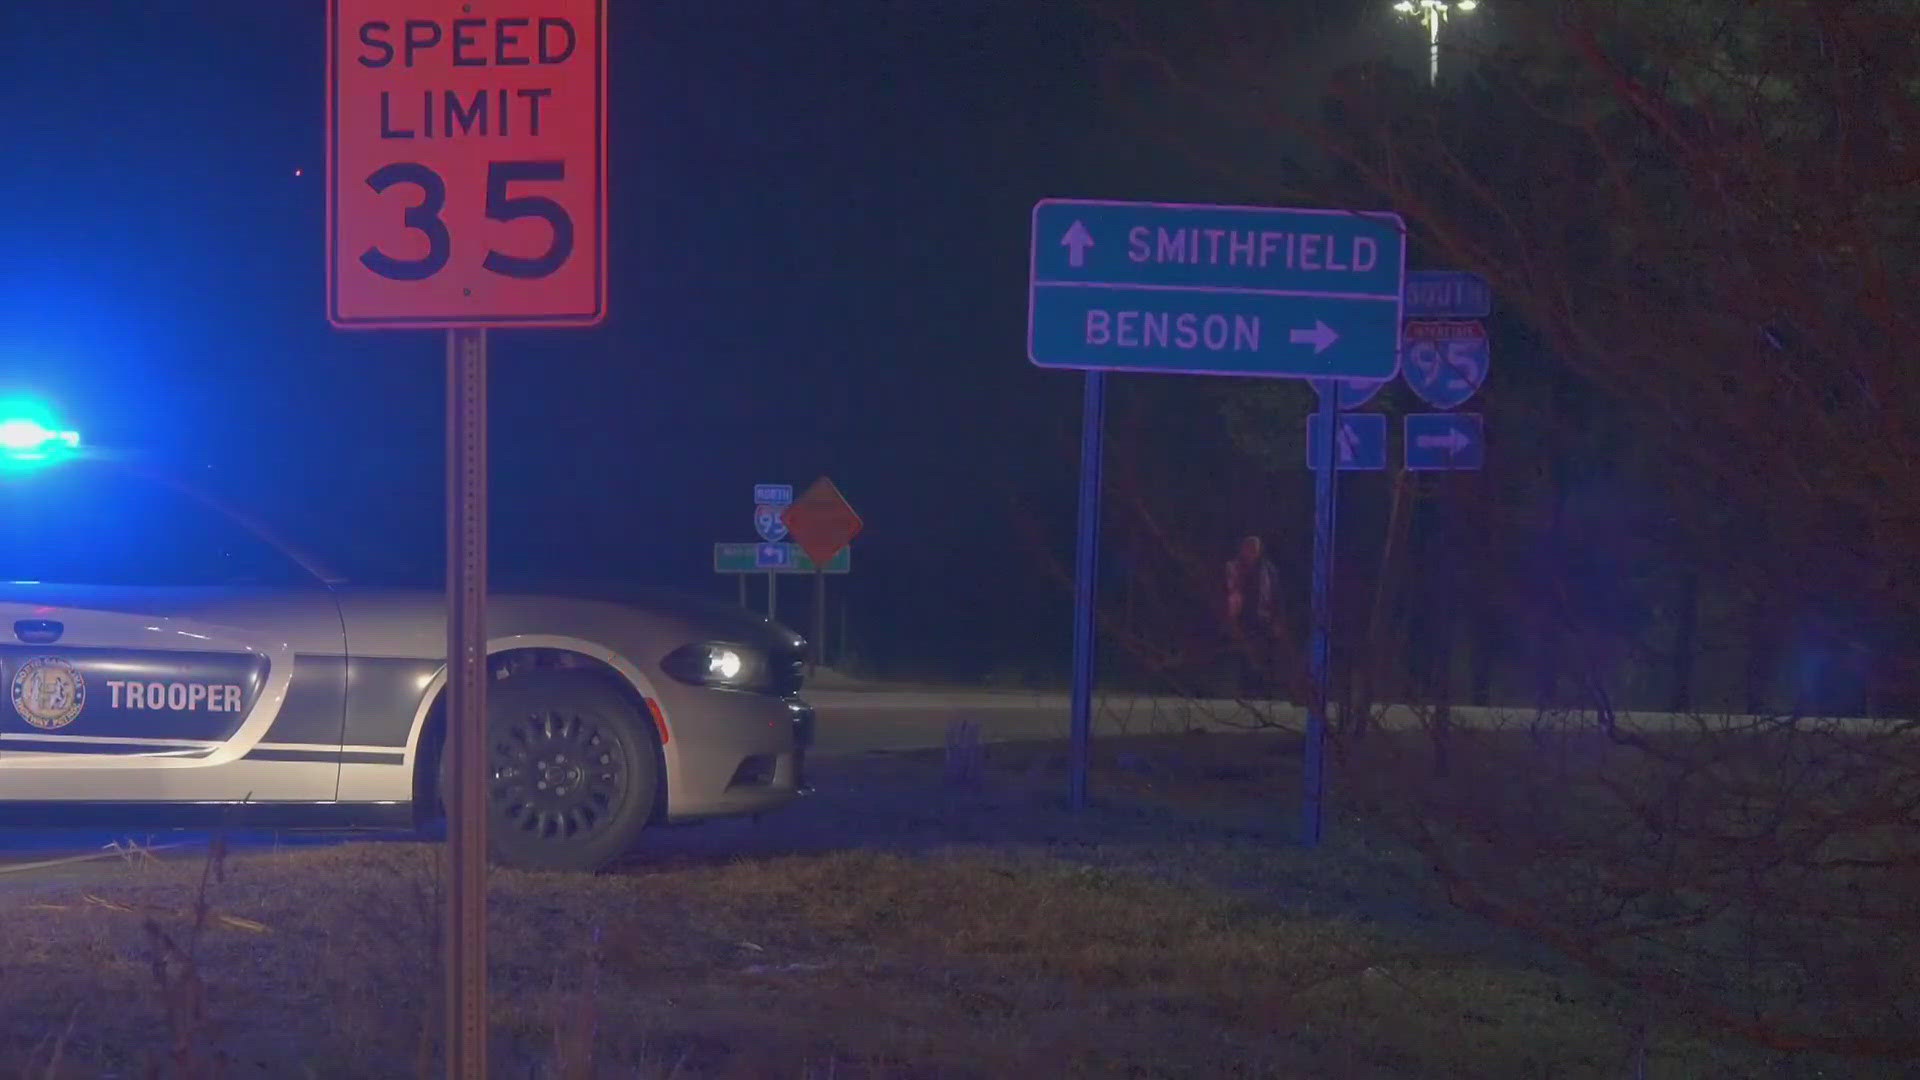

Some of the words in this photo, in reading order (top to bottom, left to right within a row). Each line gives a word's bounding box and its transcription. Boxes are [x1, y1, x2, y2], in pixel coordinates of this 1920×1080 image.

[358, 18, 576, 67] SPEED
[380, 88, 552, 139] LIMIT
[359, 160, 574, 280] 35
[1128, 226, 1377, 273] SMITHFIELD
[1086, 309, 1260, 352] BENSON
[1409, 342, 1479, 389] 95
[759, 513, 787, 533] 95
[107, 681, 241, 712] TROOPER
